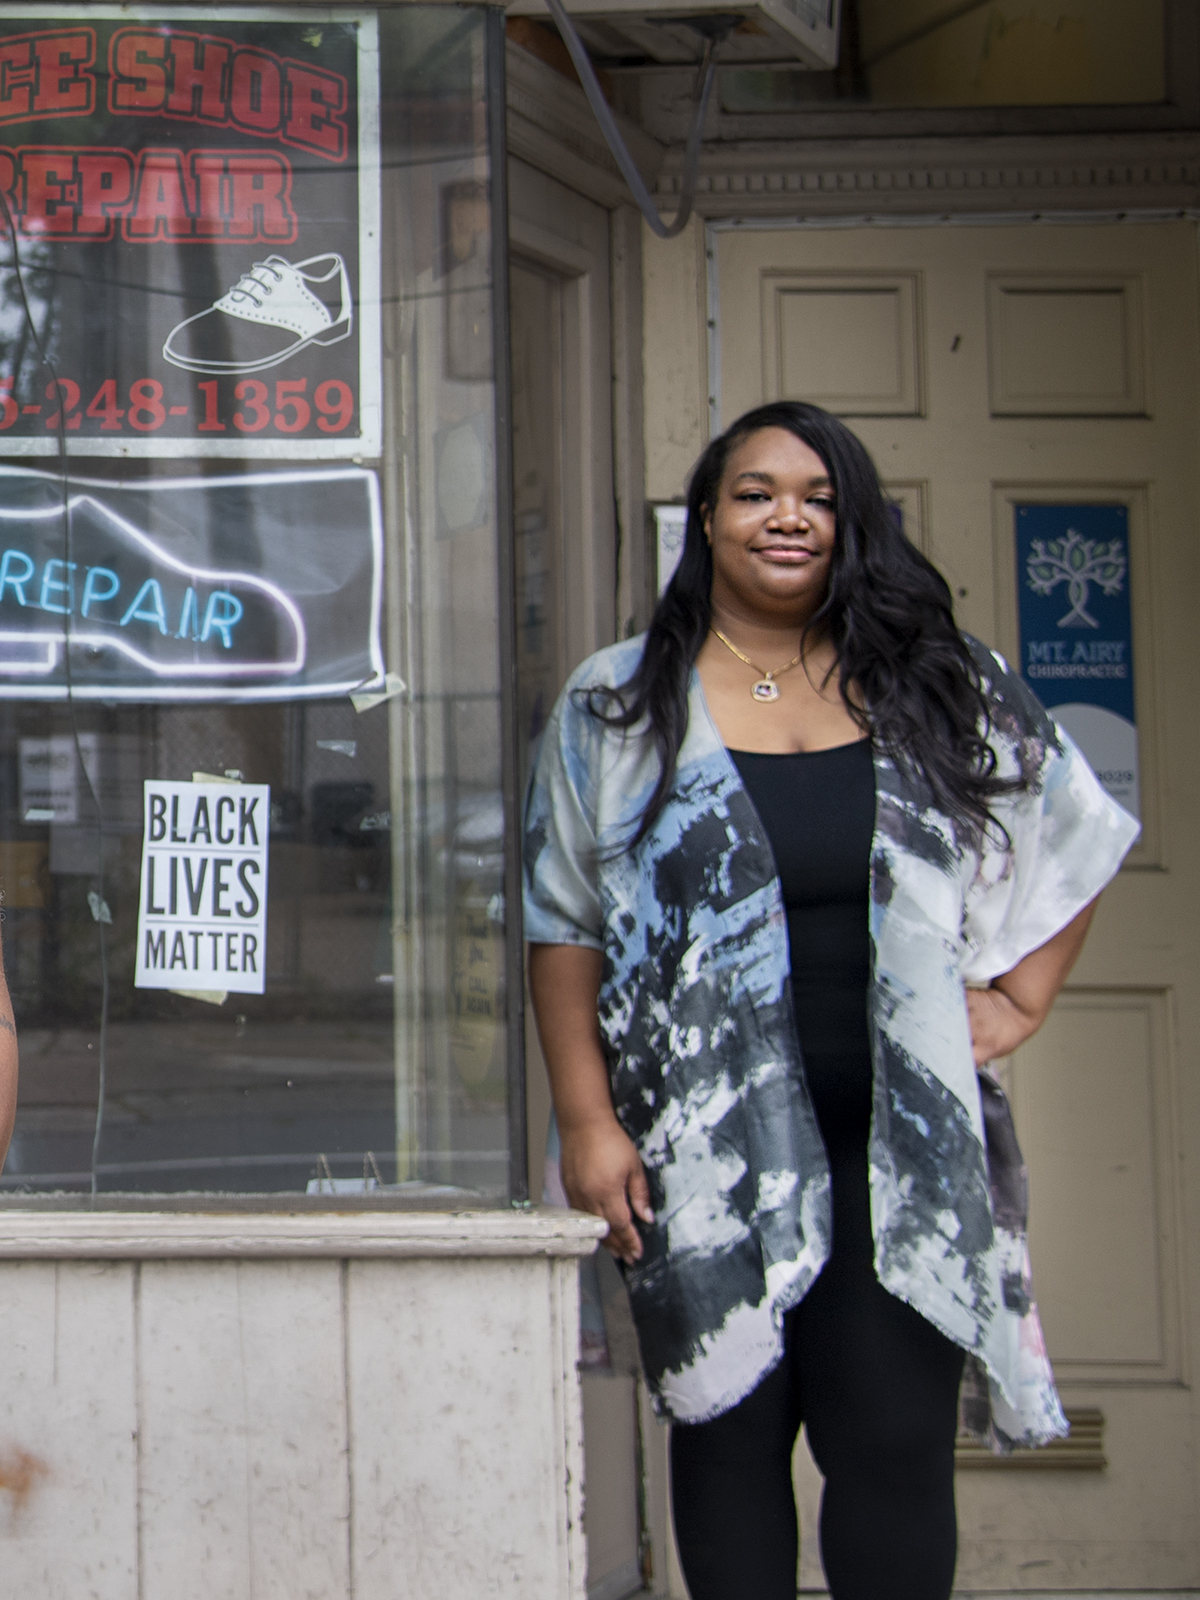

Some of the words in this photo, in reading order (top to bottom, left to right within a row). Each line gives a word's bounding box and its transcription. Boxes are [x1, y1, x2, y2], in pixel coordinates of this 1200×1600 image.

[107, 26, 349, 162] SHOE
[1027, 663, 1128, 678] CHIROPRACTIC
[1071, 641, 1126, 662] AIRY
[148, 794, 260, 846] BLACK
[146, 856, 261, 918] LIVES
[143, 930, 258, 973] MATTER
